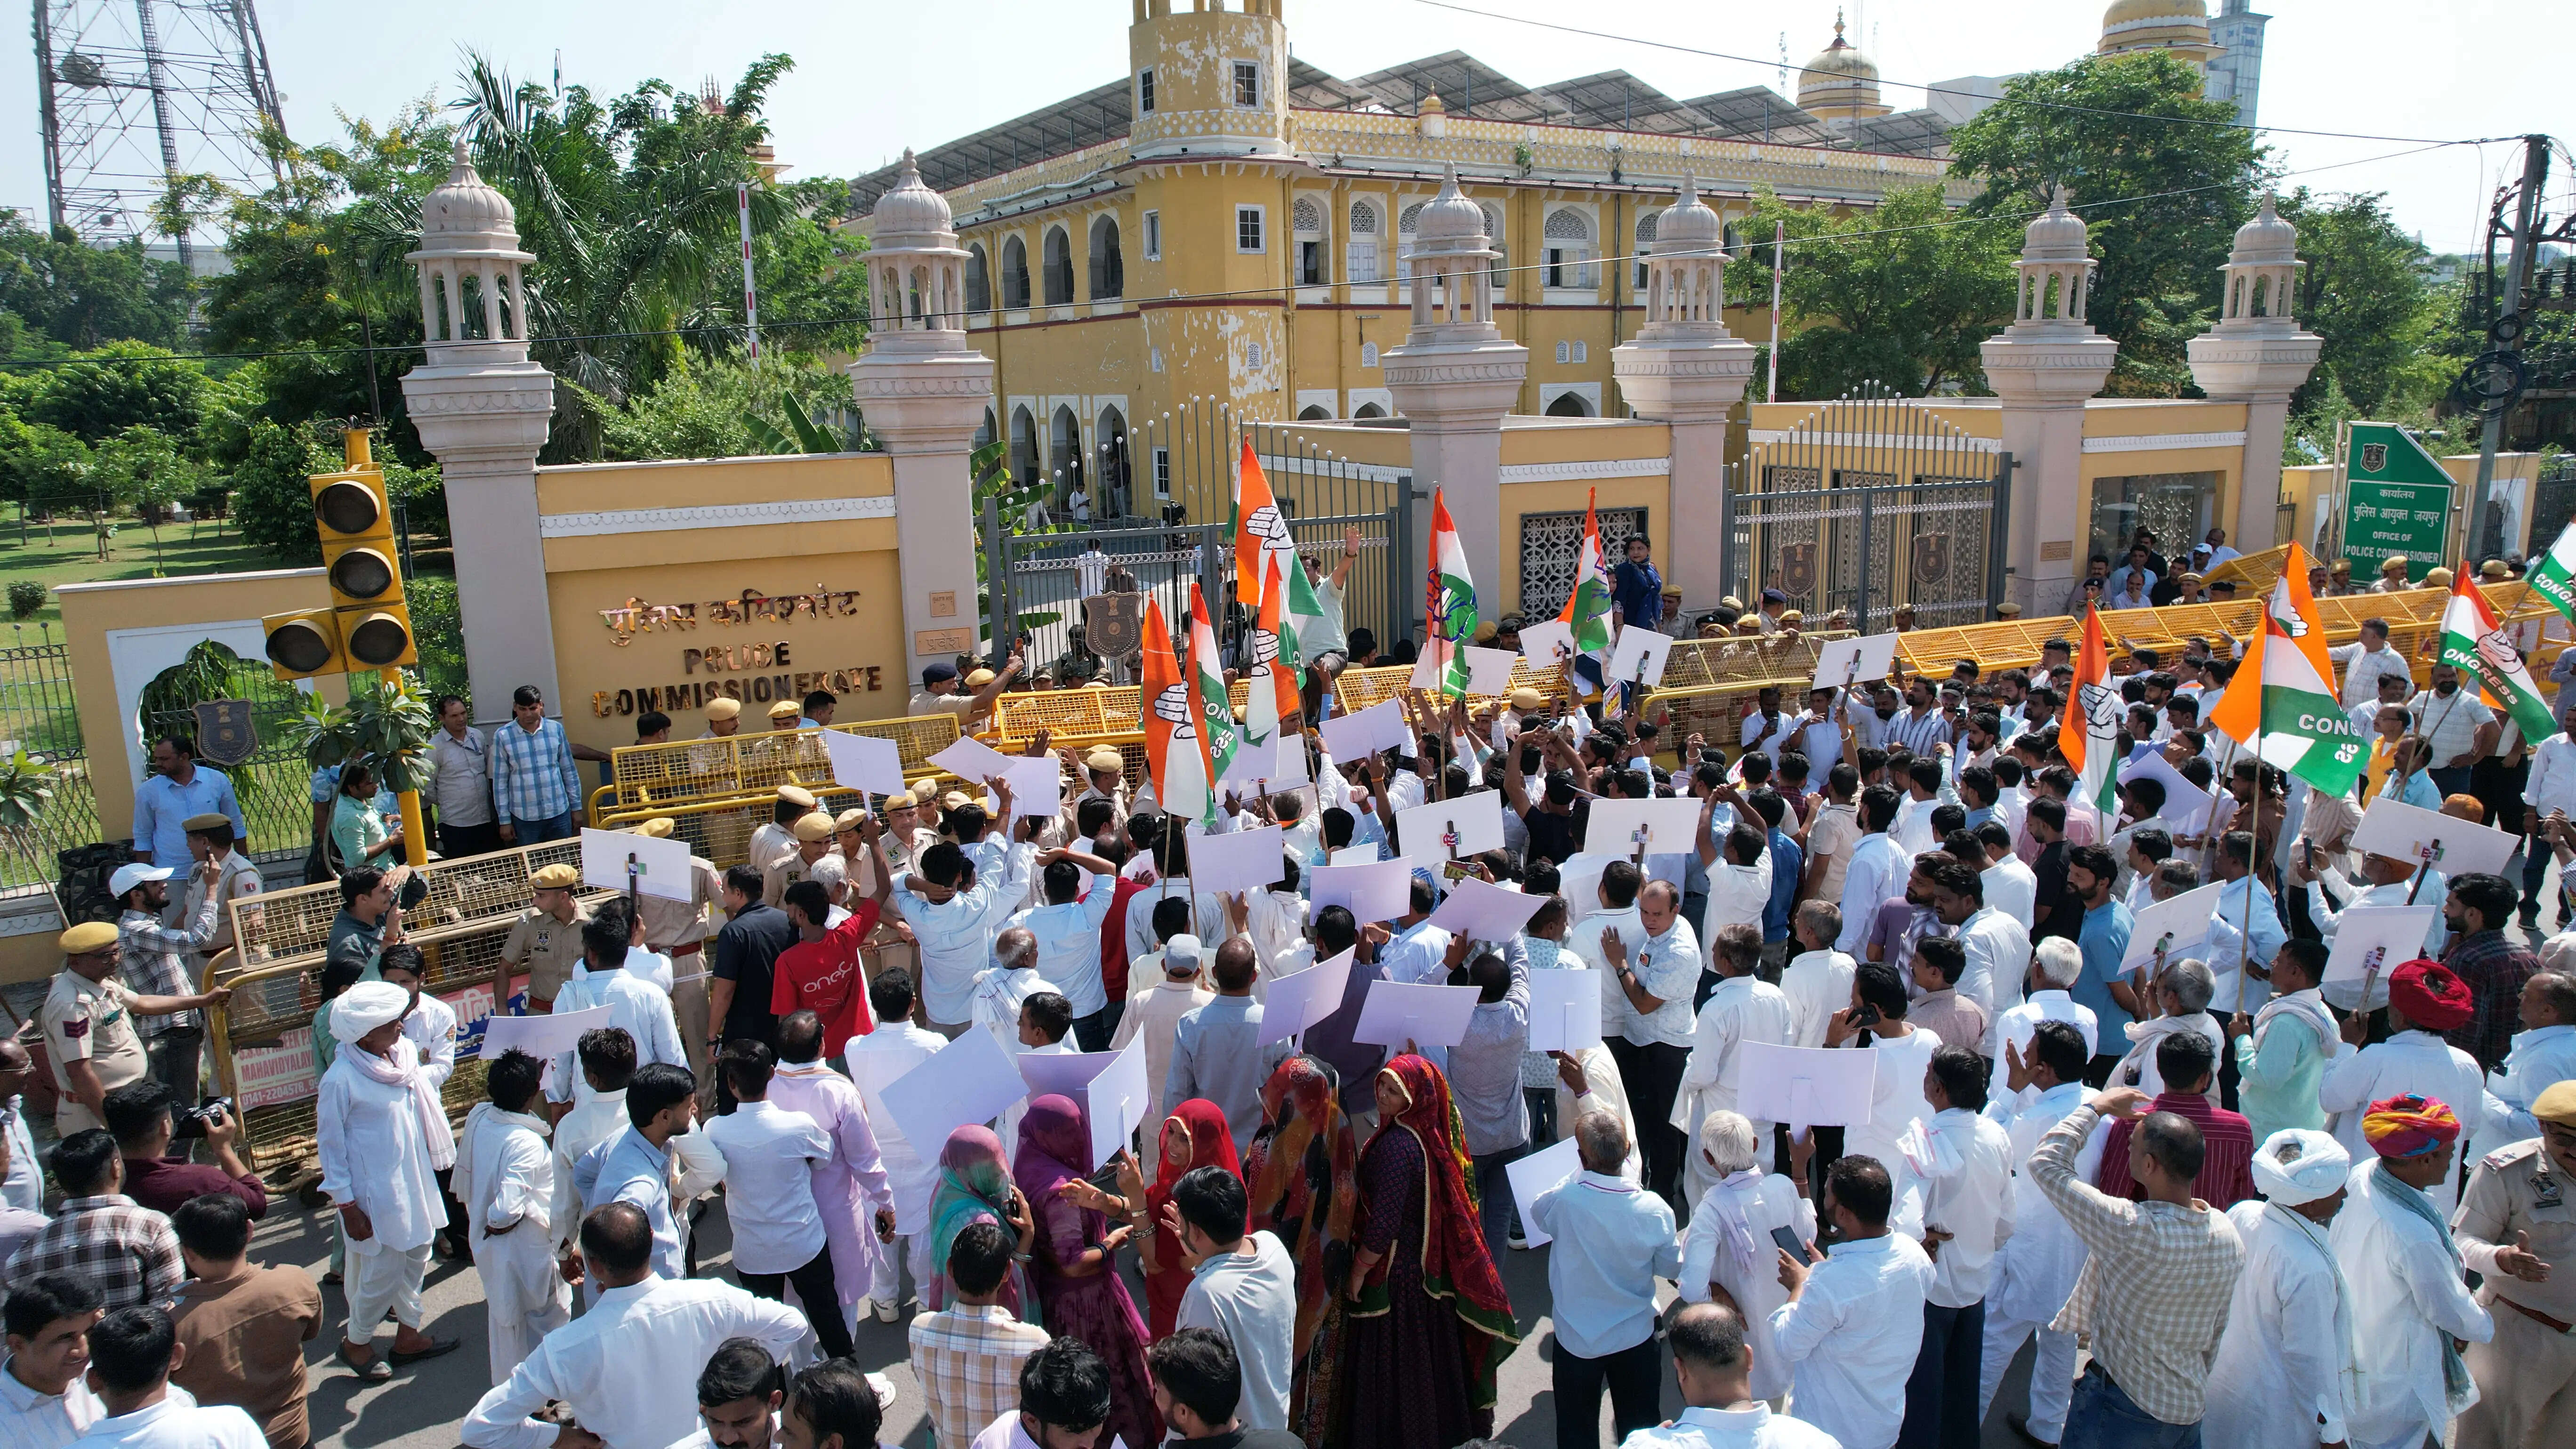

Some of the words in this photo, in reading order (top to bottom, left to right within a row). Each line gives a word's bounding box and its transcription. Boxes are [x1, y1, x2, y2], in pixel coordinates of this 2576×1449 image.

[2380, 488, 2415, 499] कार्यालय
[2354, 502, 2376, 522] पुलिस
[2380, 508, 2408, 524] आयुक्त
[2414, 510, 2440, 527] जयपुर
[2373, 531, 2399, 540] OFFICE
[2401, 534, 2412, 542] OF
[2345, 545, 2374, 557] POLICE
[2376, 548, 2439, 564] COMMISSIONER
[598, 597, 699, 647] पुलिस
[703, 582, 861, 627] कमिश्नरेट
[926, 632, 961, 651] प्रवेश
[684, 641, 791, 674] POLICE
[592, 666, 882, 718] COMMISSIONERATE
